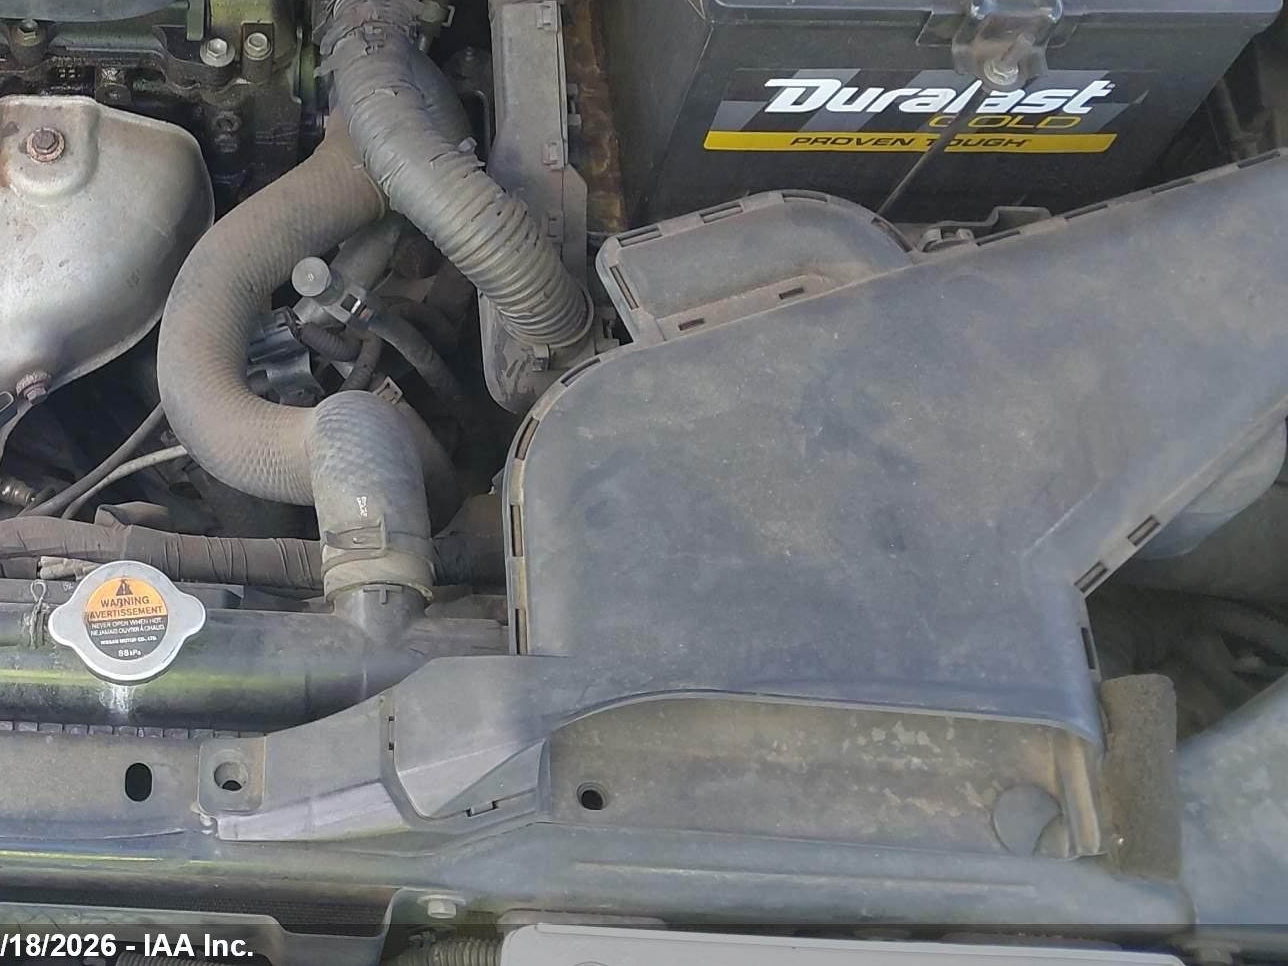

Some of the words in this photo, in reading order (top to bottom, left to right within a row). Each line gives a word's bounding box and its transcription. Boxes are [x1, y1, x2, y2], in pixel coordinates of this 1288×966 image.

[765, 79, 1112, 114] Duralast
[790, 137, 915, 147] PROVEN
[101, 596, 149, 608] WARNING
[90, 606, 163, 619] AVERTISSEMENT
